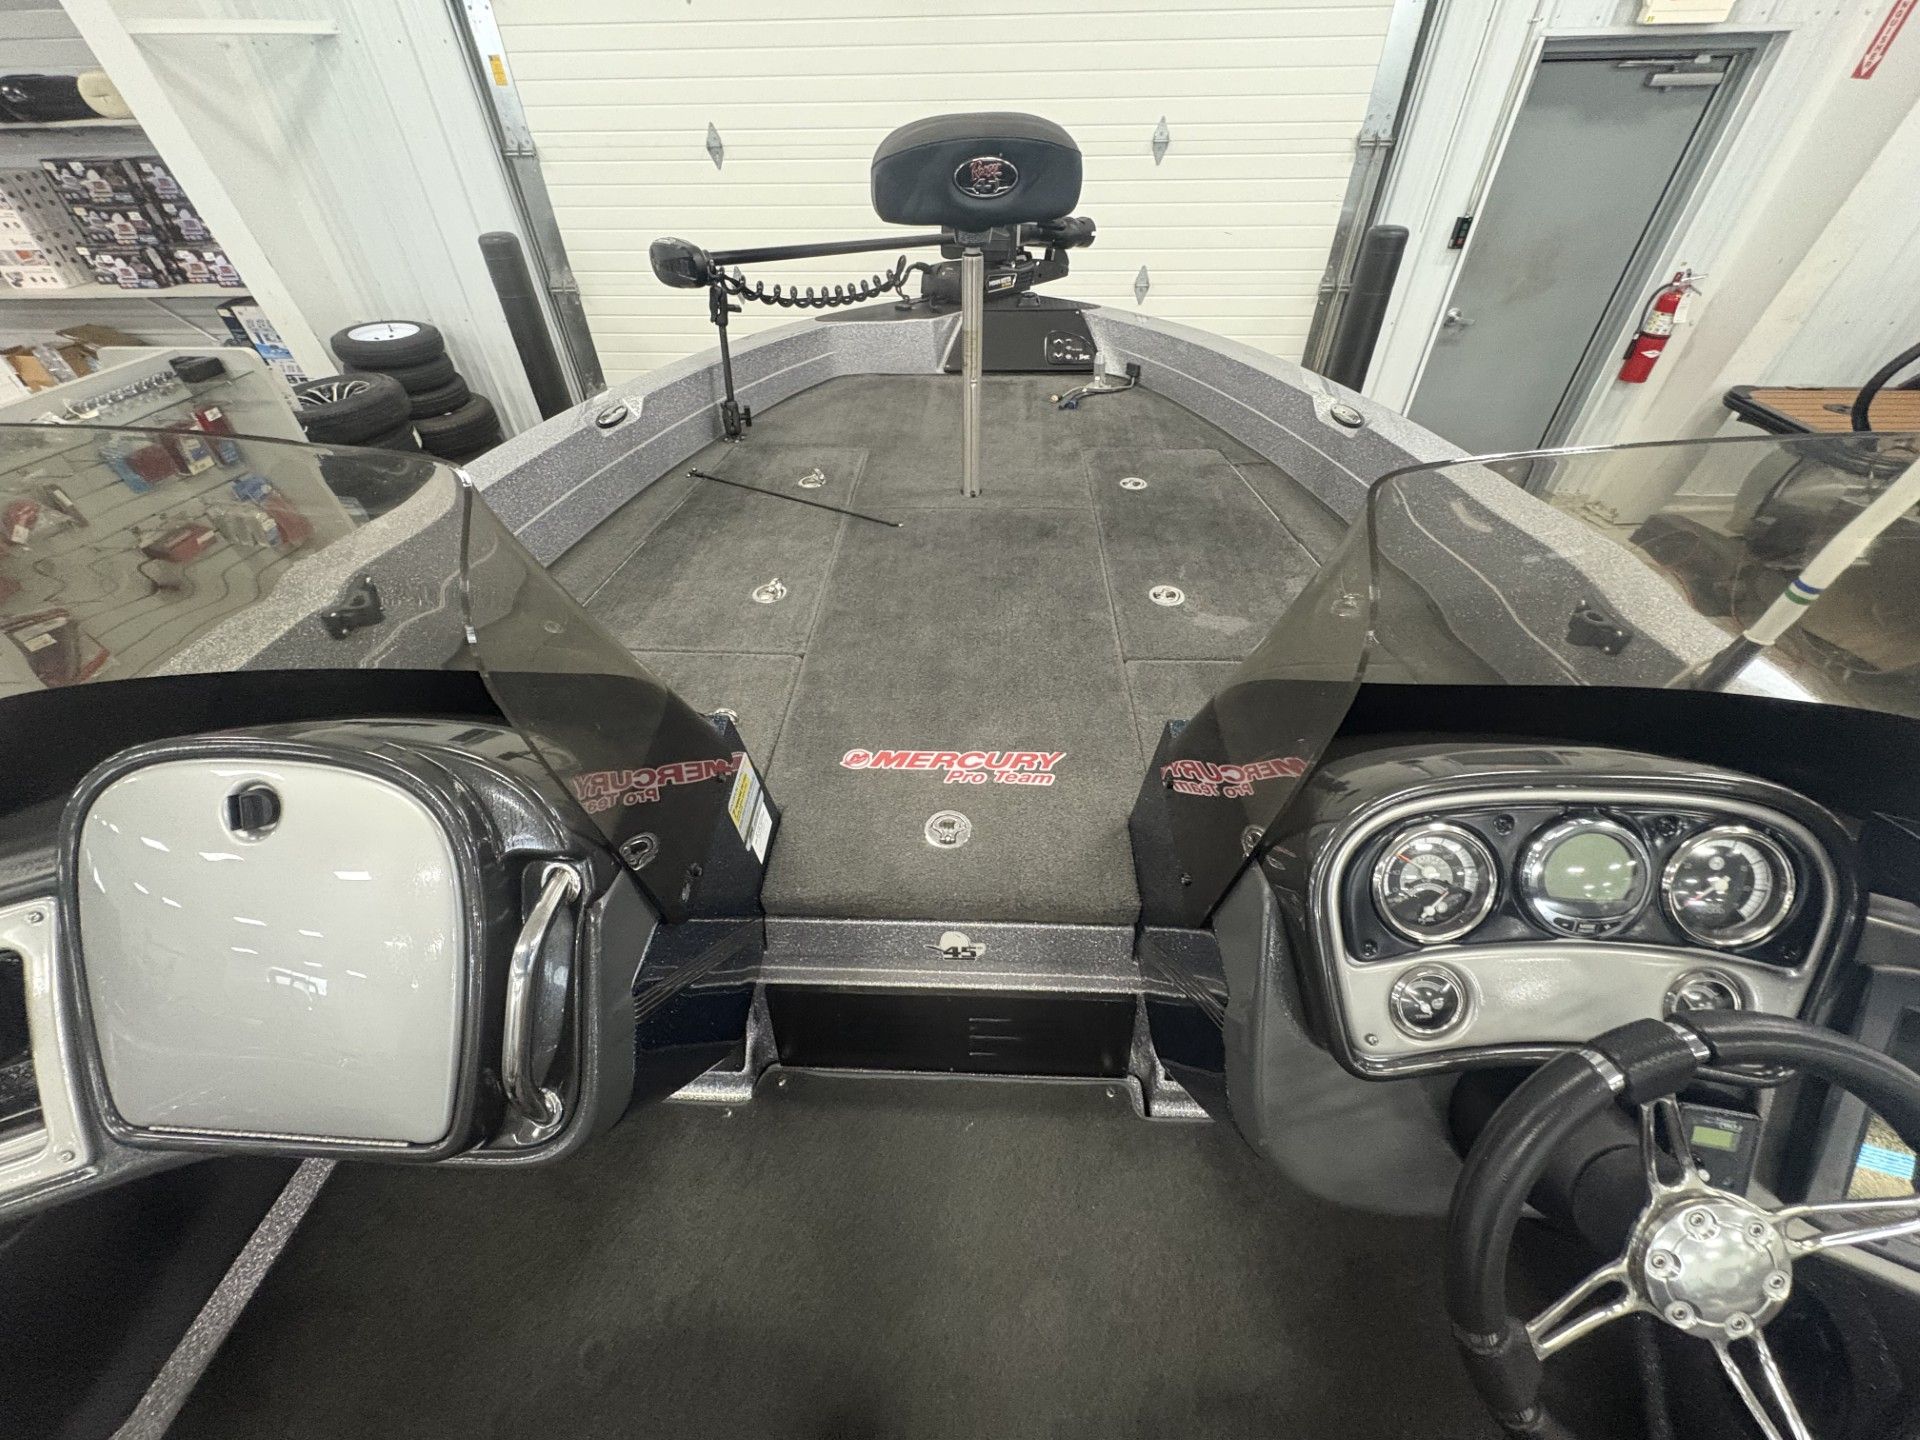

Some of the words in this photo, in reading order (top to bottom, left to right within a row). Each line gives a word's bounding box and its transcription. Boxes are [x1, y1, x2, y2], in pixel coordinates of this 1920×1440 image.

[869, 750, 1067, 771] MERCURY
[943, 769, 987, 785] Pro
[992, 769, 1056, 786] Team
[943, 946, 977, 958] 45
